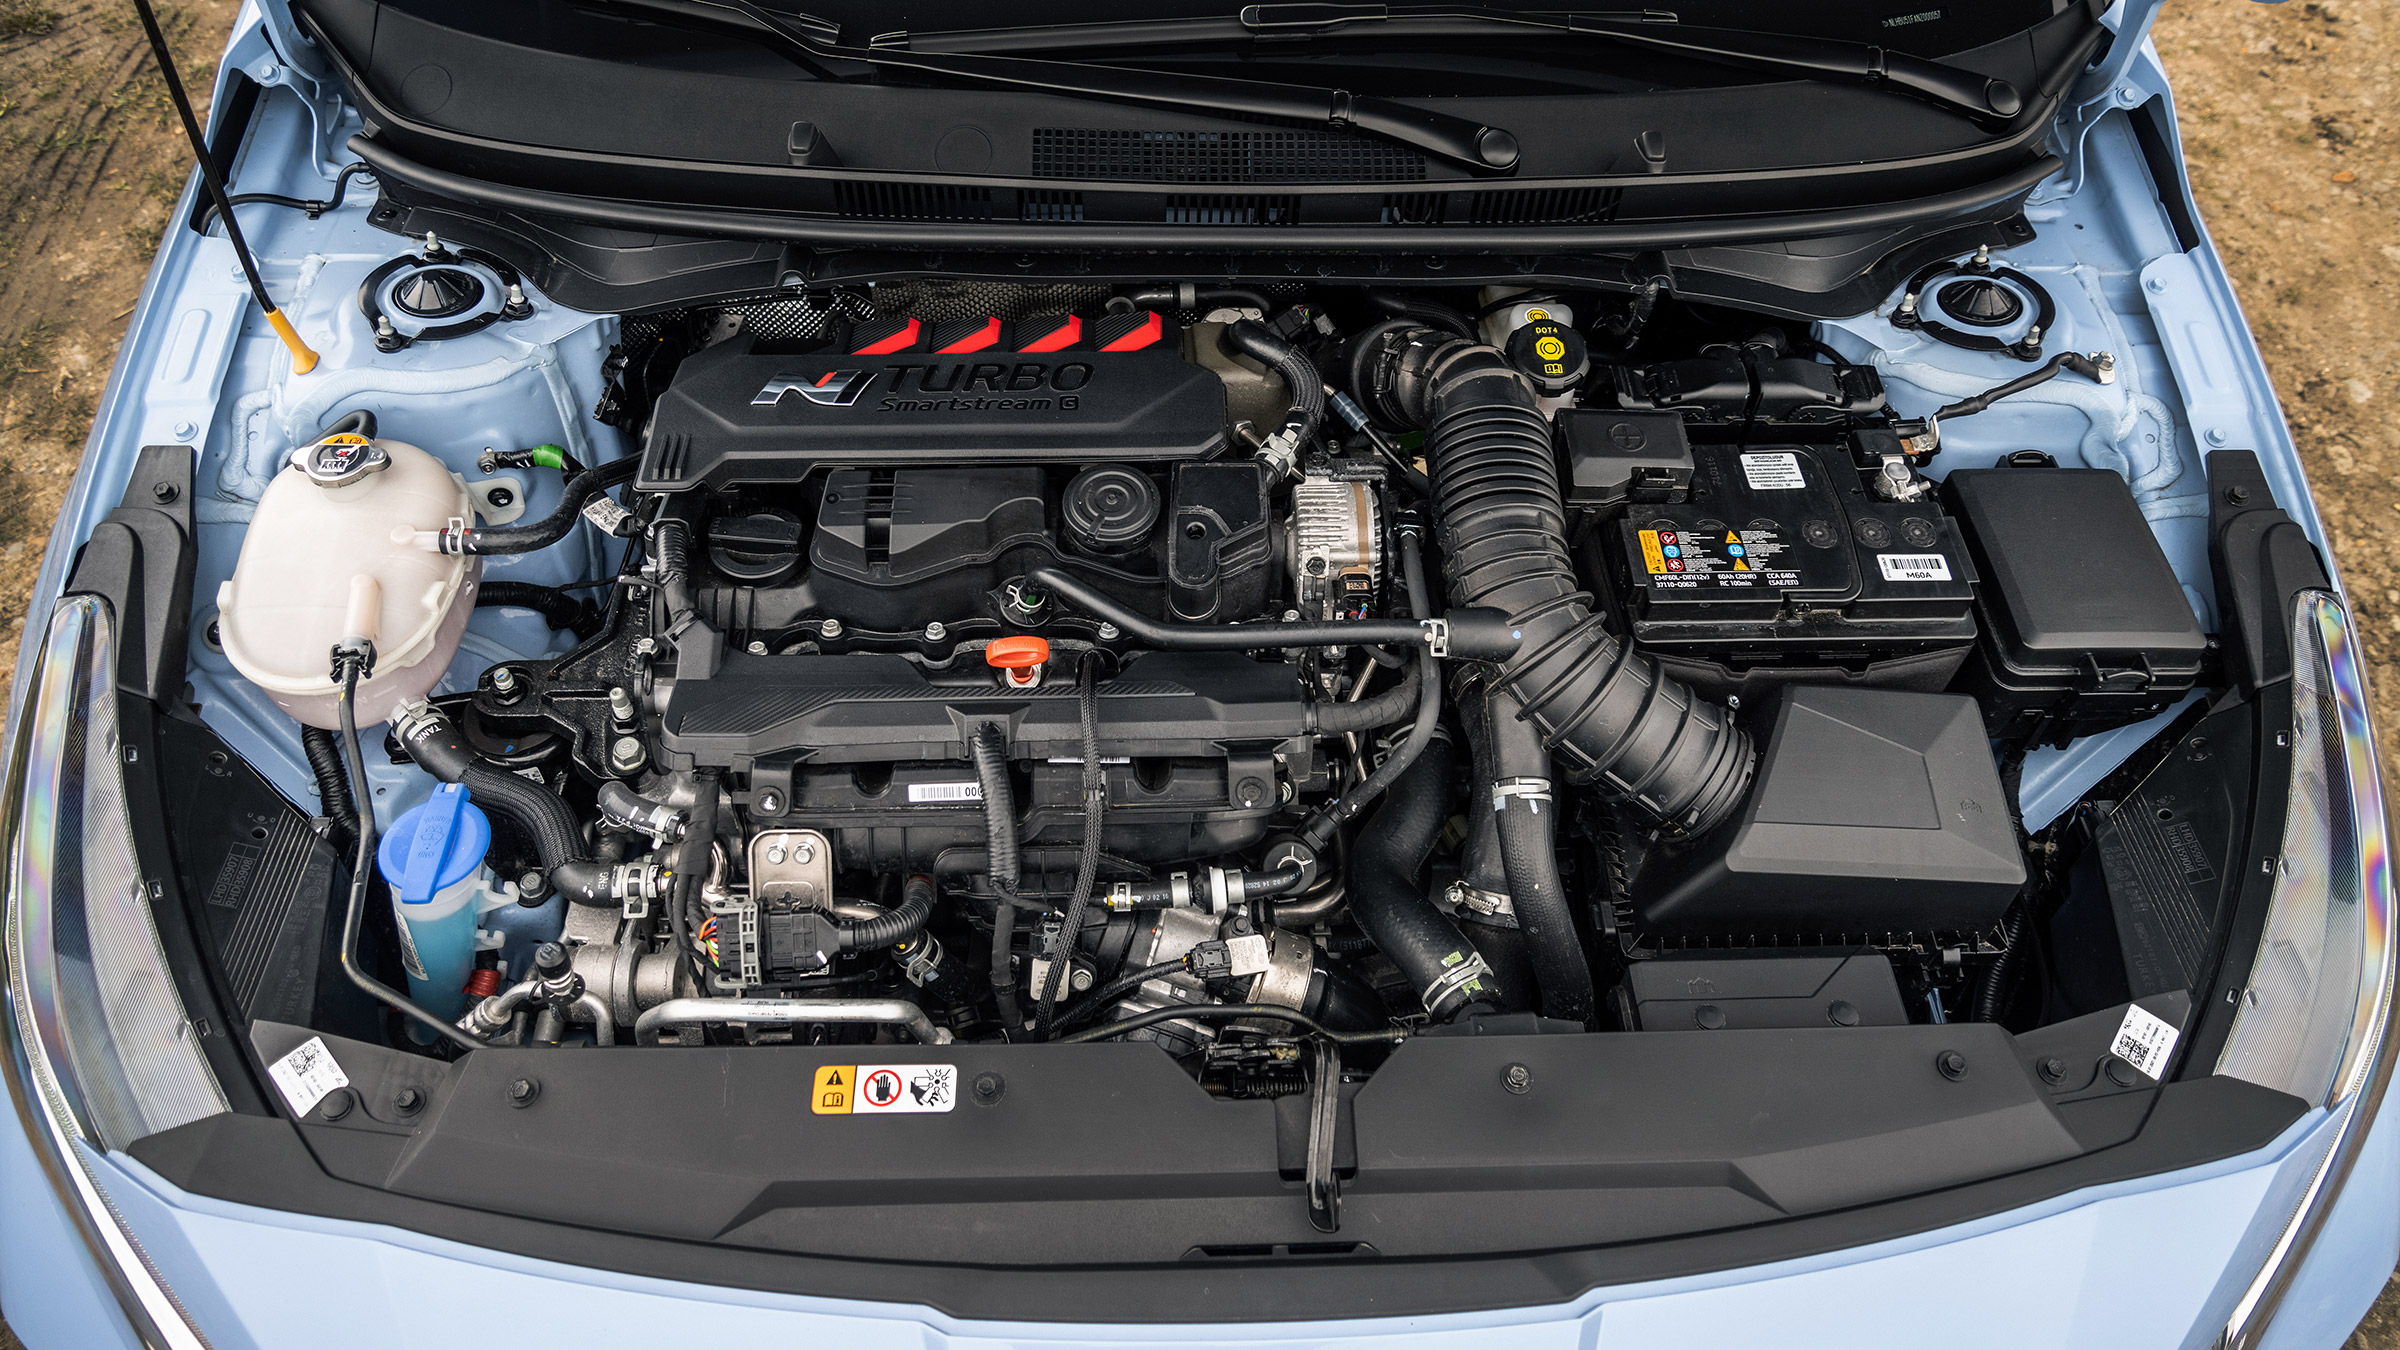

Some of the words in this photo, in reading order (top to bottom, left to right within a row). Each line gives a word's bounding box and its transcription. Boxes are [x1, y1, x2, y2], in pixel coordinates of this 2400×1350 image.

[884, 362, 1095, 394] TURBO
[876, 395, 1052, 412] Smartstream
[416, 724, 442, 744] TANK
[2166, 826, 2181, 846] RHD
[2175, 846, 2195, 871] 35908
[2179, 824, 2193, 842] LHD
[2188, 842, 2208, 868] 35907
[211, 884, 227, 904] LHD
[221, 856, 239, 884] 35907
[225, 887, 241, 907] RHD
[234, 858, 253, 886] 35908
[598, 872, 609, 890] ENG
